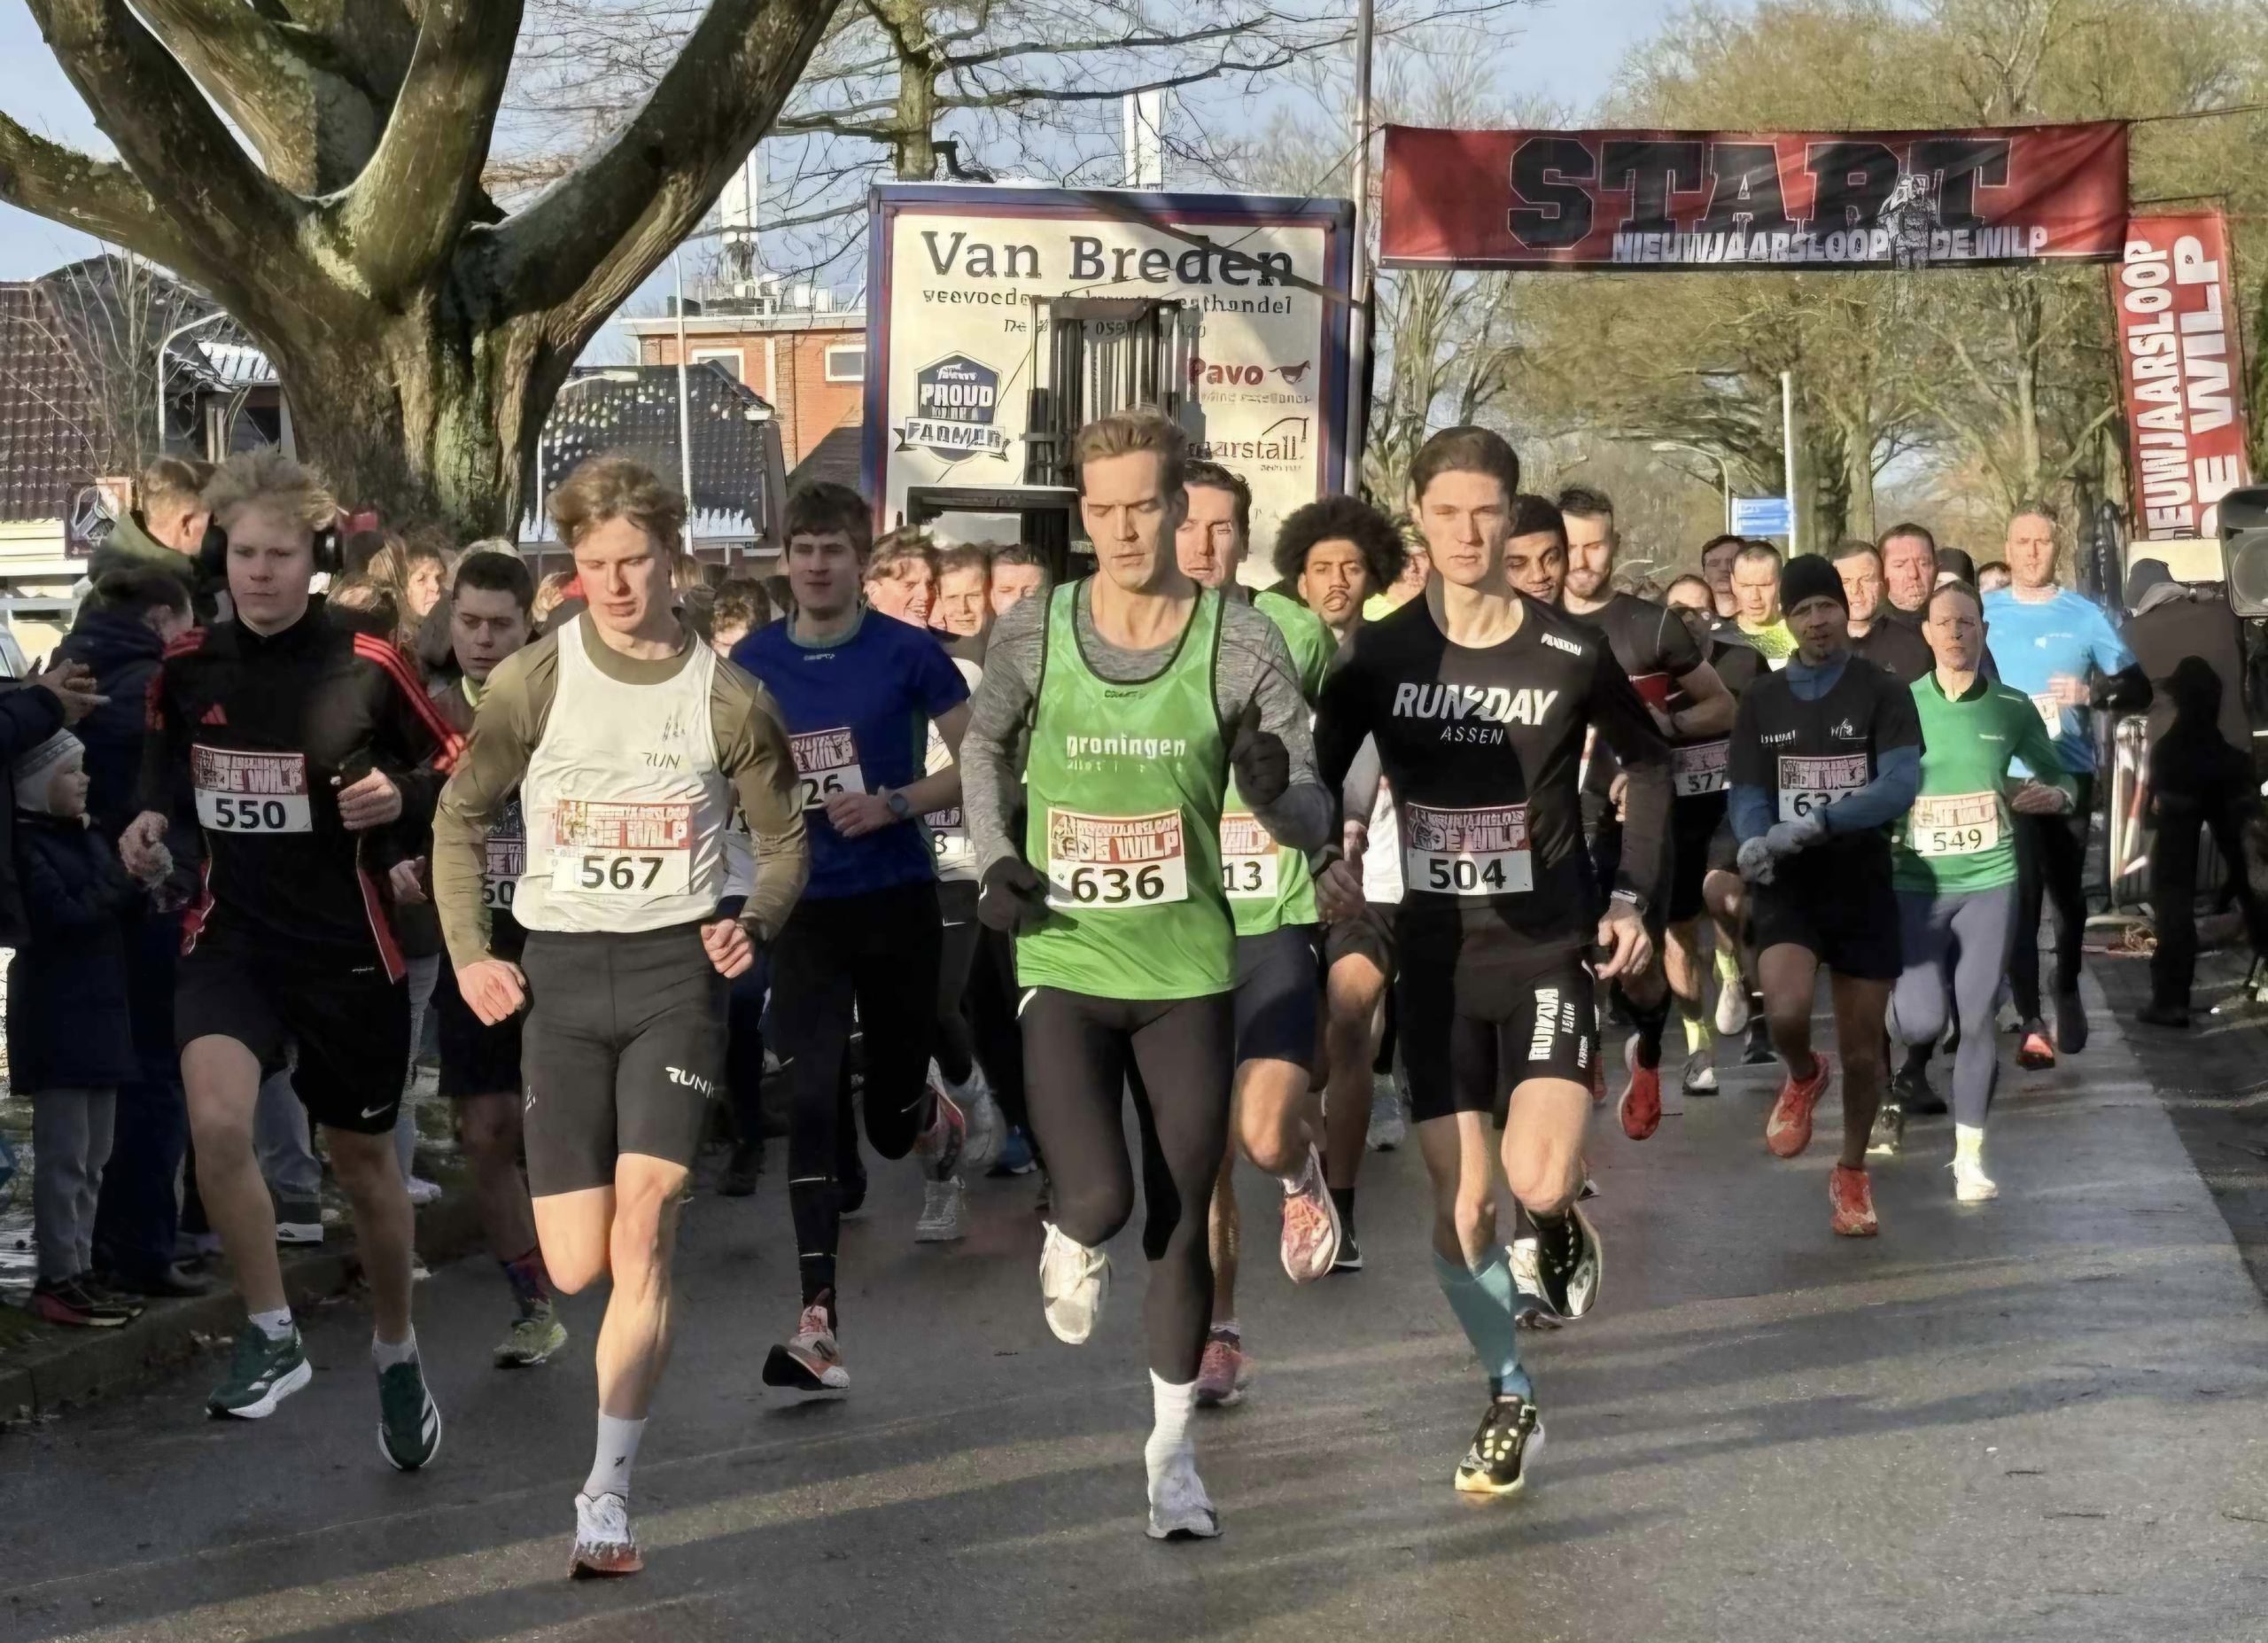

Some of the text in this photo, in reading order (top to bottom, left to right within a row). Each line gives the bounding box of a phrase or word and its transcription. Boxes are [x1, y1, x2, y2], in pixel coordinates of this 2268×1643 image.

[1507, 136, 2012, 251] START
[921, 231, 1293, 287] Van Breden
[1929, 229, 1971, 259] DE
[1976, 225, 2047, 258] WILP
[2173, 235, 2233, 434] WILP
[1189, 357, 1264, 385] Pavo
[1392, 682, 1558, 726] RUN2DAY
[1441, 726, 1503, 744] ASSEN
[215, 798, 286, 829] 550
[1933, 829, 1983, 852] 549
[581, 855, 664, 890] 567
[1071, 864, 1164, 903] 636
[1429, 858, 1507, 890] 504
